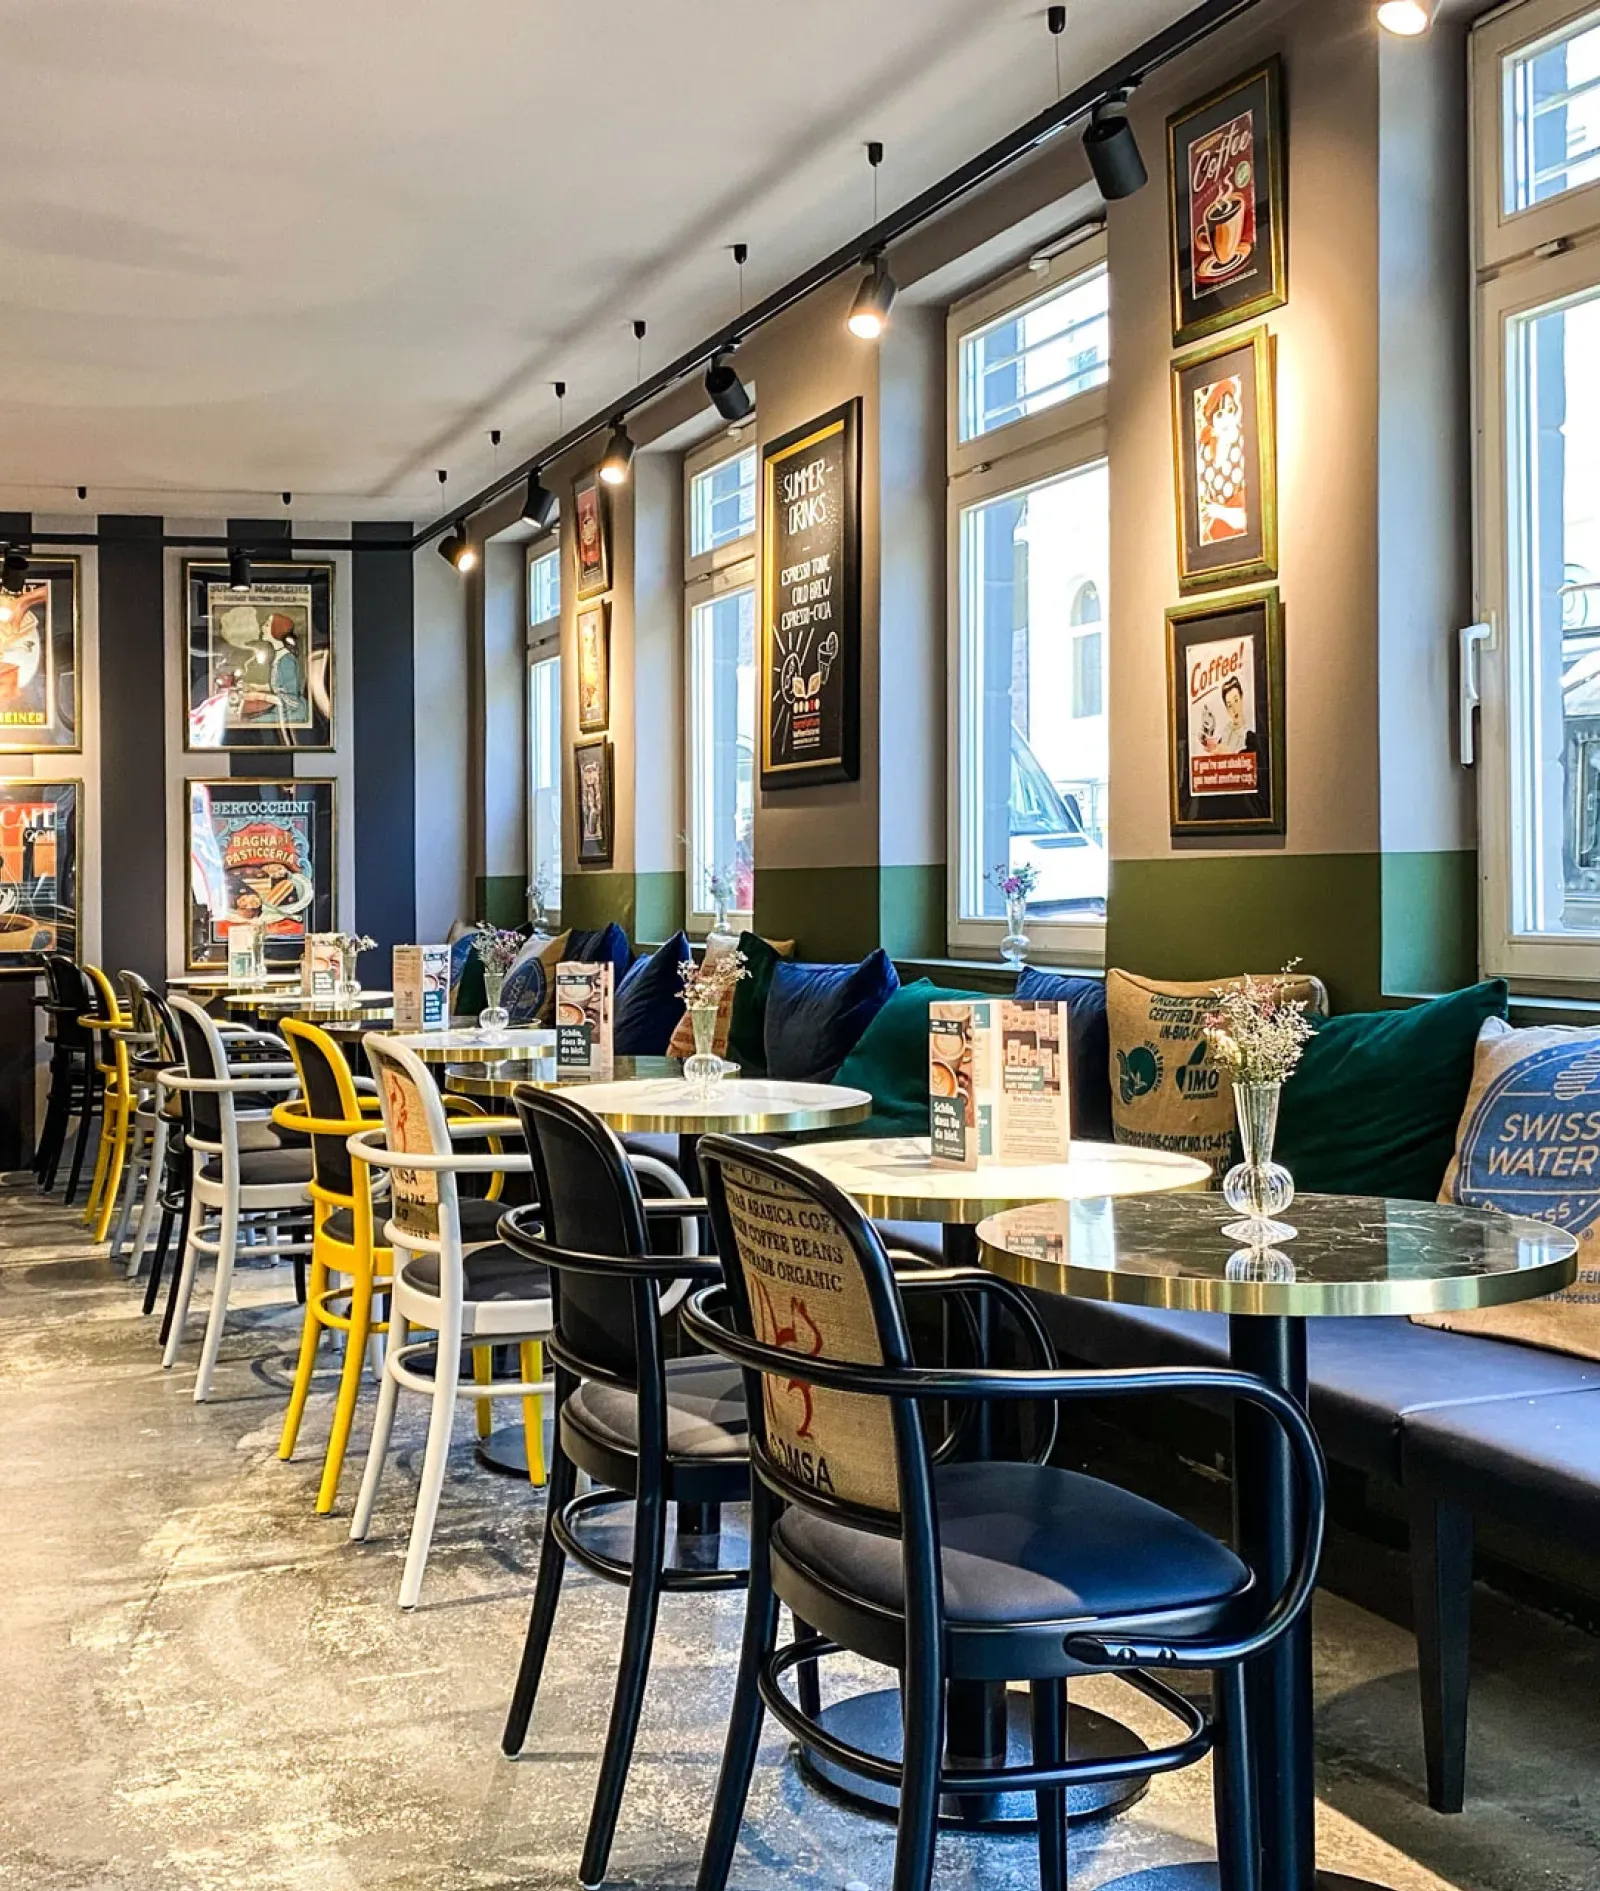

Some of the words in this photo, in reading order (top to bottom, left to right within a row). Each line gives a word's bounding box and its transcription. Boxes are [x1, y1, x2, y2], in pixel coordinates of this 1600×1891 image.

[1193, 122, 1250, 193] Coffee
[788, 492, 827, 536] DRINKS
[1190, 641, 1245, 698] Coffee!
[212, 802, 309, 815] BERTOCCHINI
[226, 847, 294, 866] PASTICCERIA
[1149, 1006, 1193, 1024] CERTIFIED
[1187, 1068, 1220, 1093] IMO
[1499, 1111, 1600, 1142] SWISS
[1487, 1145, 1599, 1177] WATER
[747, 1197, 796, 1228] ARABICA
[748, 1223, 790, 1254] COFFEE
[790, 1237, 844, 1265] BEANS
[776, 1261, 843, 1293] ORGANIC
